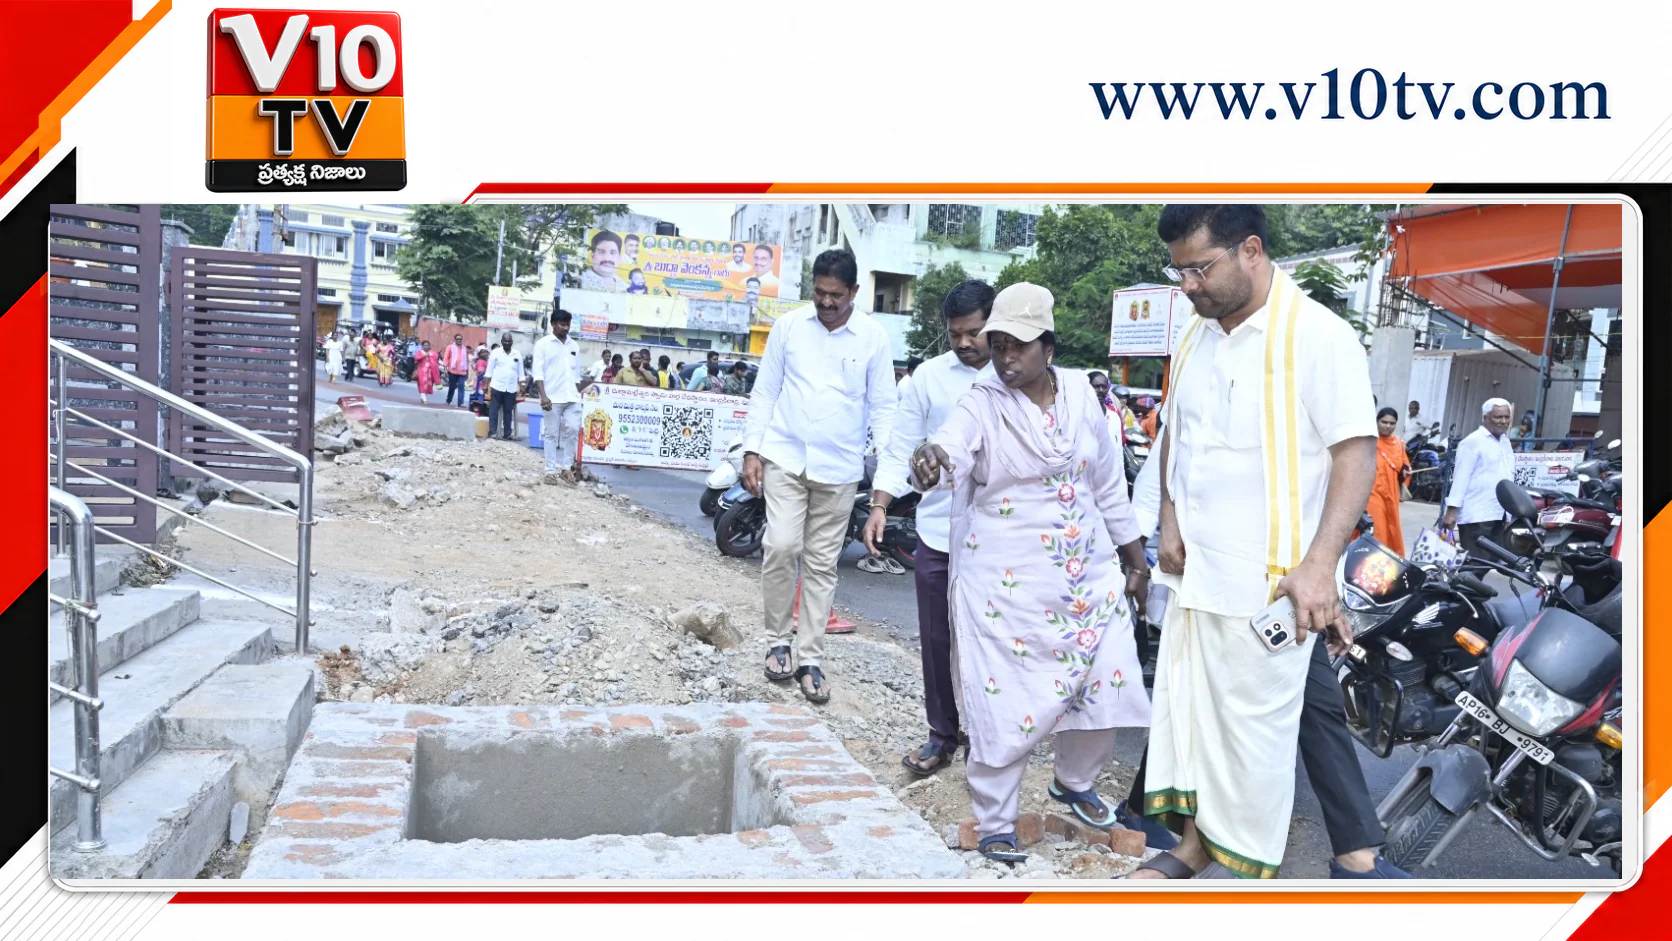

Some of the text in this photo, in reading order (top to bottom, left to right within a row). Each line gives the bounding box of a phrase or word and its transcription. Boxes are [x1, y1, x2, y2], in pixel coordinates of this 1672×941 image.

[618, 413, 661, 426] 9552300009
[1491, 719, 1511, 735] BJ
[1520, 739, 1549, 762] 9791
